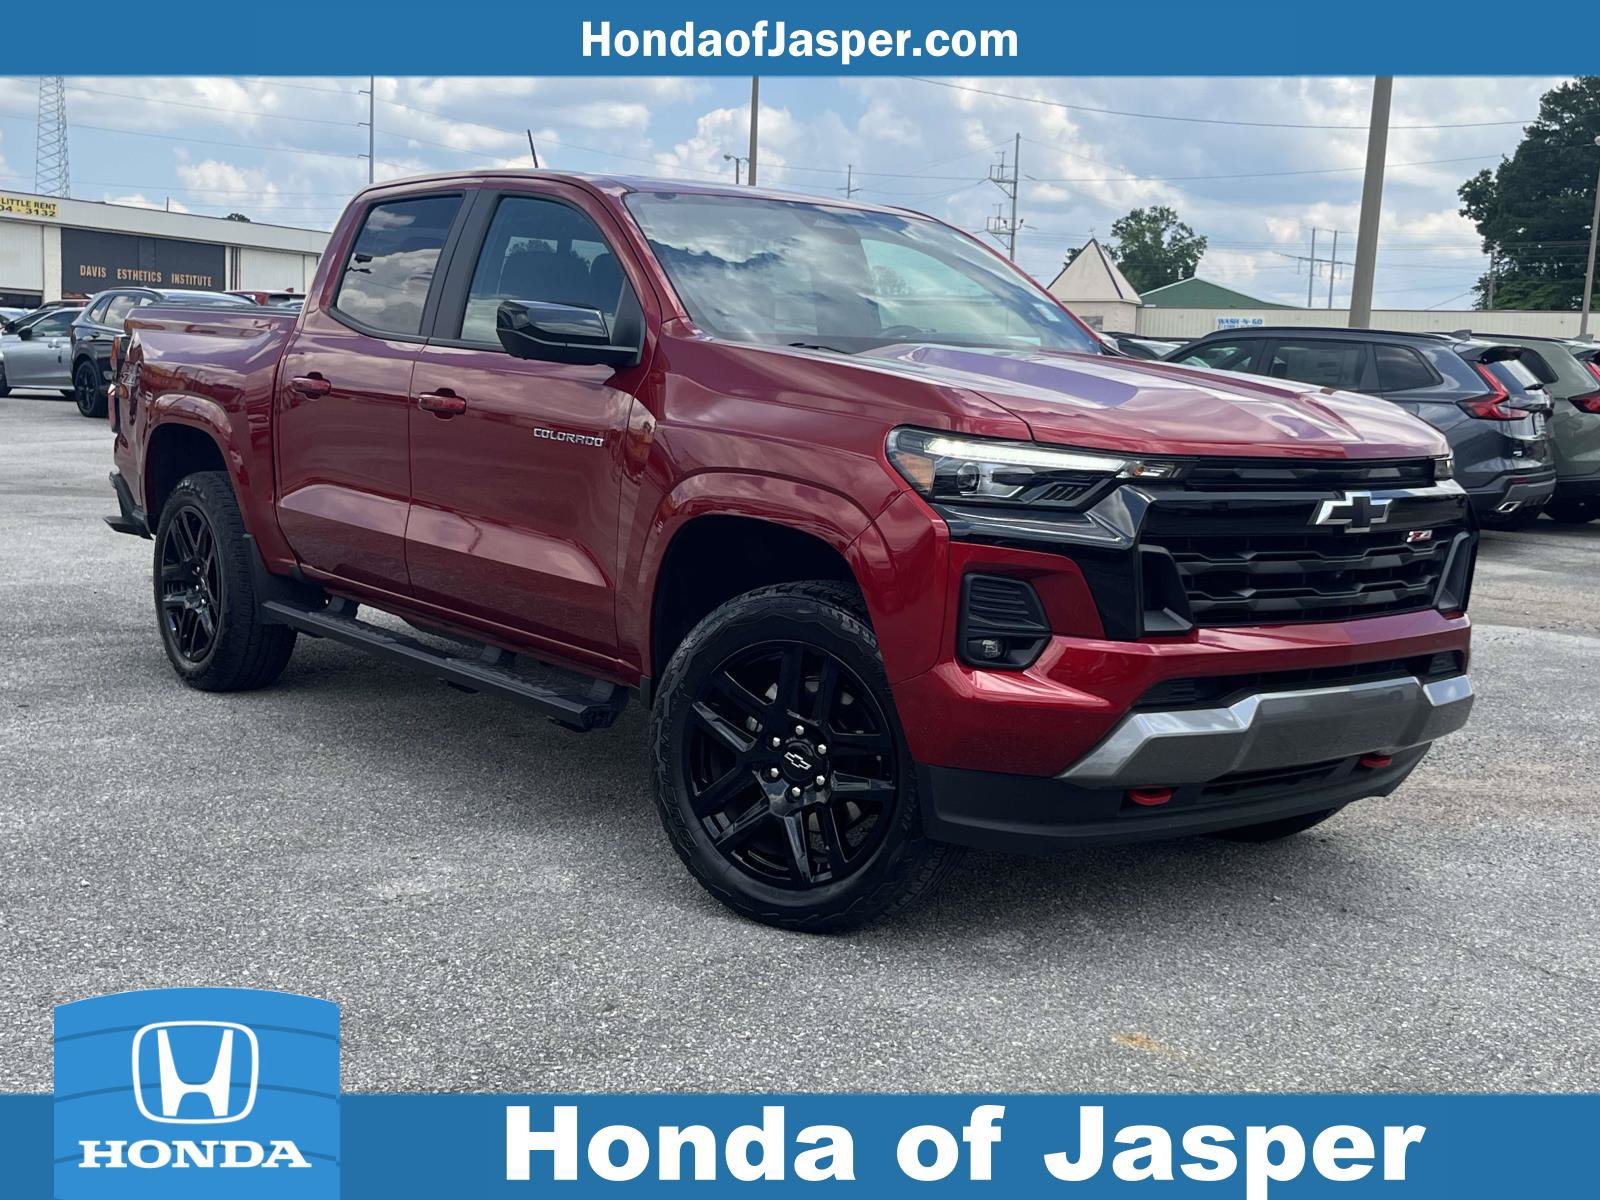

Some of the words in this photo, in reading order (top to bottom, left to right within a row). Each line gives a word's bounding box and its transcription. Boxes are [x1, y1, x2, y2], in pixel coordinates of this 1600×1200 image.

[1, 197, 31, 208] LITTLE
[34, 201, 56, 211] RENT
[80, 264, 107, 278] DAVIS
[117, 268, 162, 283] ESTHETICS
[171, 273, 212, 287] INSTITUTE
[533, 427, 604, 447] COLORADO
